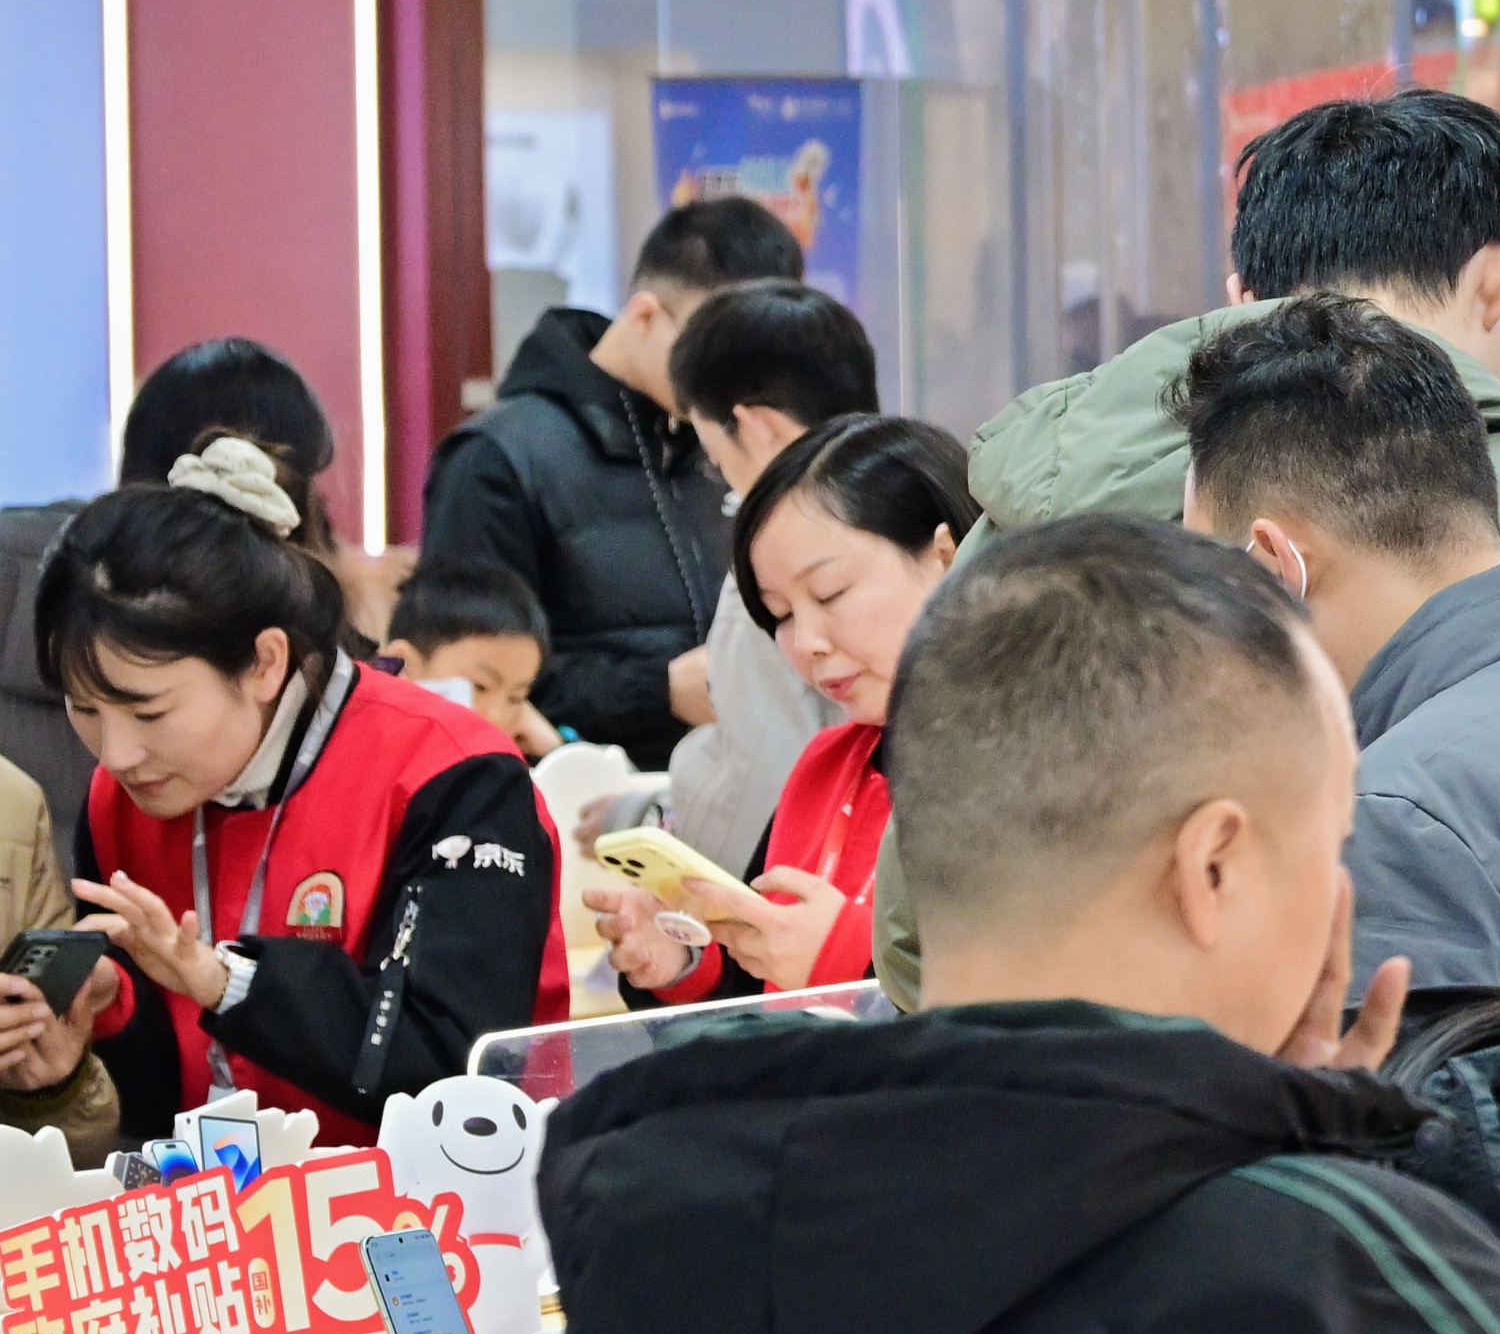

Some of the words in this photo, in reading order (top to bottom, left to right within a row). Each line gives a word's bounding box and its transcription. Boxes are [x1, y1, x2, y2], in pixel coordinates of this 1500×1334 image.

[474, 843, 525, 877] 京东
[0, 1175, 240, 1312] 手机数码
[251, 1270, 273, 1320] 国补
